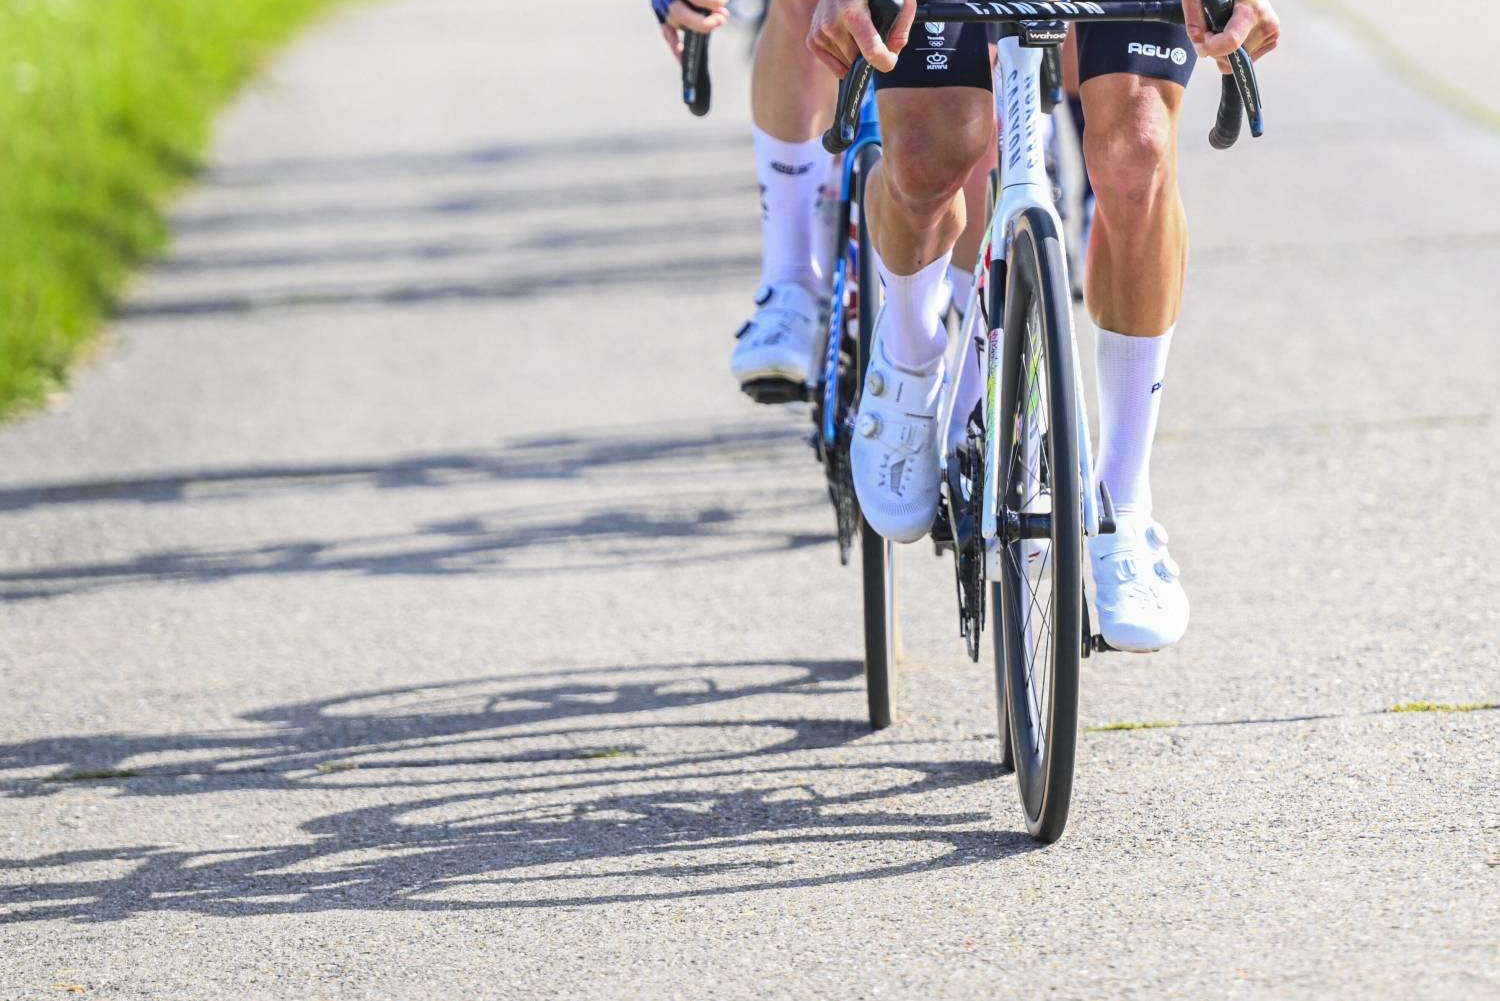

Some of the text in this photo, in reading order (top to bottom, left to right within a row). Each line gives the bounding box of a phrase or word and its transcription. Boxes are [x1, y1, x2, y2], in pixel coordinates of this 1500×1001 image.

[966, 2, 1105, 15] CANYON
[1029, 31, 1066, 40] wahoo
[1128, 42, 1171, 59] AGU
[850, 62, 871, 118] URA-ACE
[1007, 69, 1021, 170] CANYON
